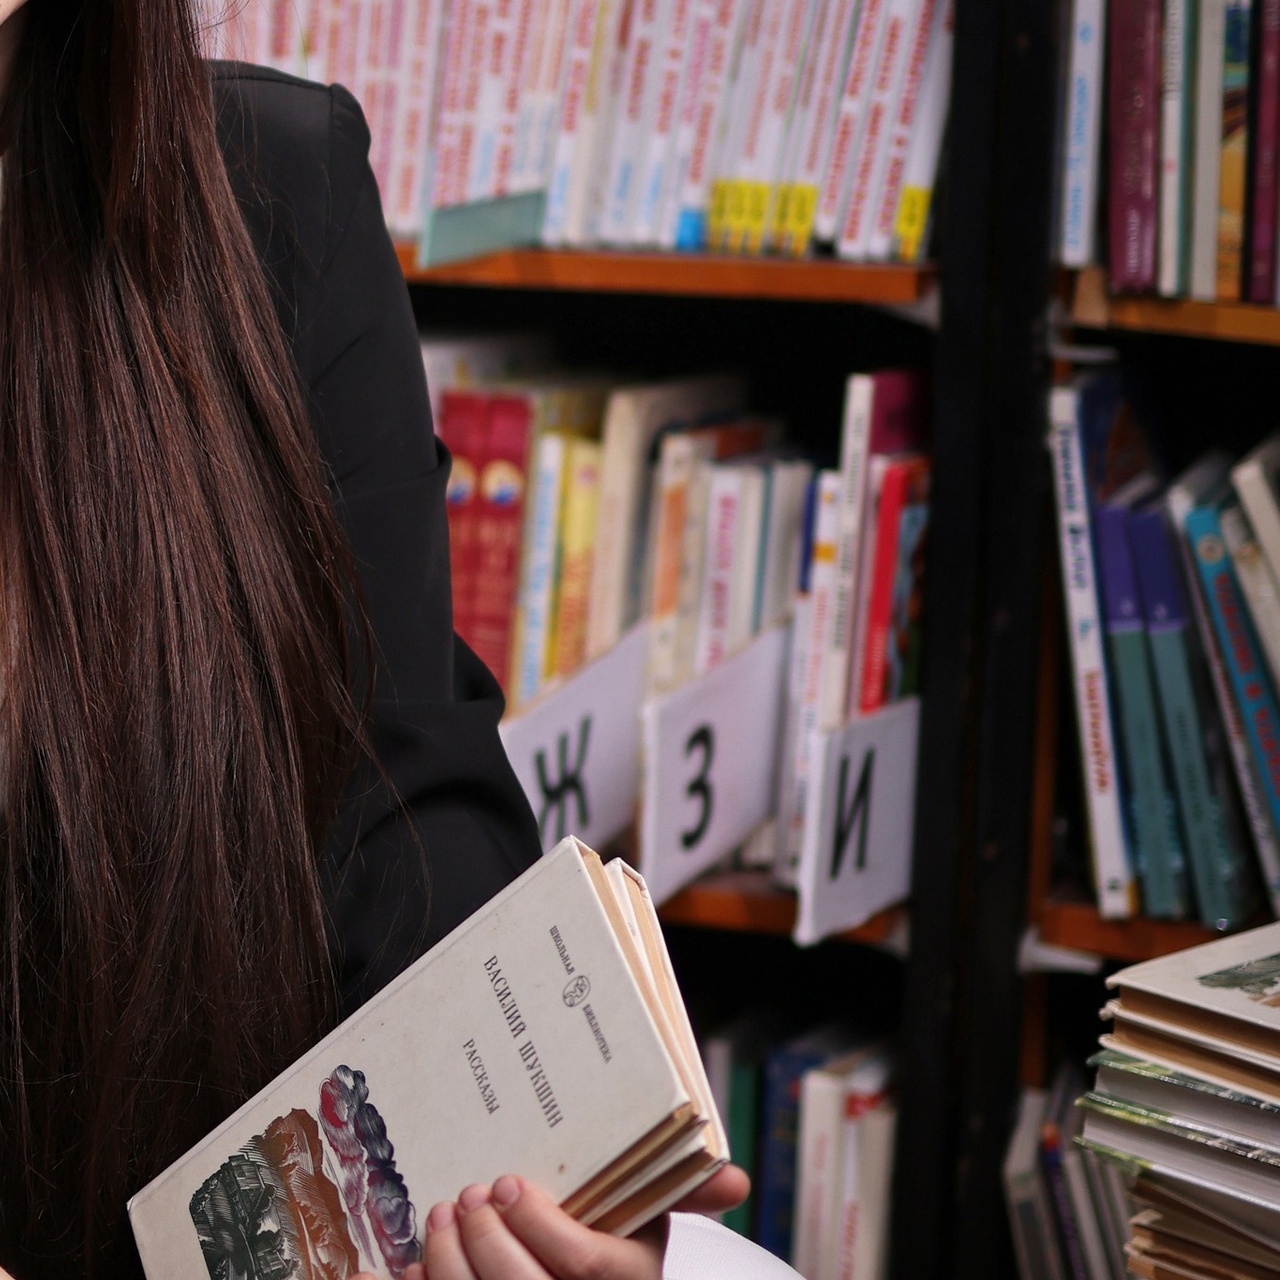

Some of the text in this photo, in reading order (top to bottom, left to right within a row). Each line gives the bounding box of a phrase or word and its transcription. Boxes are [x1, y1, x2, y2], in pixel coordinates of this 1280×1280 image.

[533, 715, 593, 846] Ж
[679, 723, 716, 851] З
[830, 747, 876, 882] И
[483, 954, 566, 1129] ВАСИЛИЙ ШУКШИН
[548, 925, 613, 1065] ШКОЛЬНАЯ БИБЛИОТЕКА
[461, 1037, 502, 1116] РАССКАЗЫ
